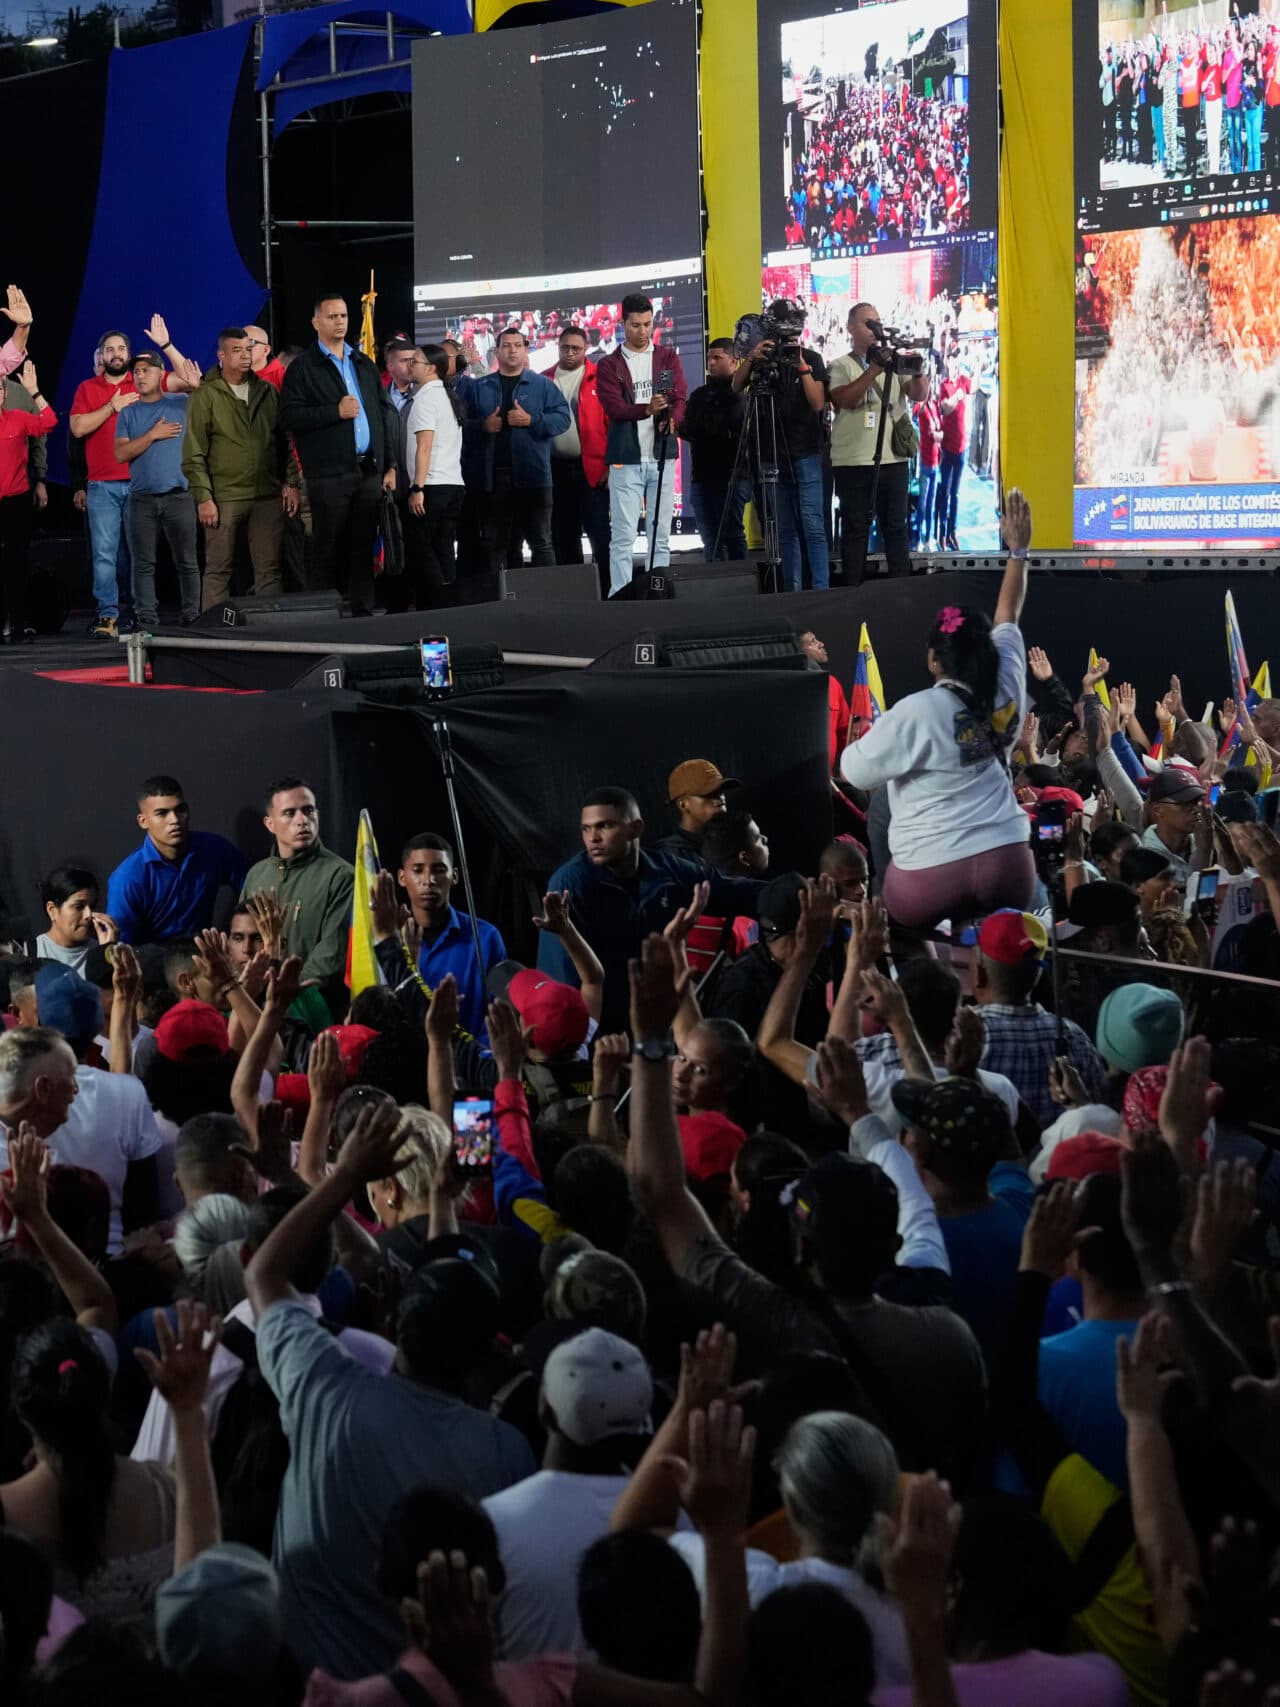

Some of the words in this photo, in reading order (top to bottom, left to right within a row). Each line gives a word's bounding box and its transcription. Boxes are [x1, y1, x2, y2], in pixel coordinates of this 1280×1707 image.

[1110, 472, 1145, 484] MIRANDA
[1134, 493, 1207, 512] JURAMENTACIÓN
[1209, 496, 1222, 511] DE
[1223, 495, 1240, 510] LOS
[1134, 514, 1198, 530] BOLIVARIANOS
[1199, 514, 1212, 529] DE
[1213, 514, 1237, 528] BASE
[655, 579, 661, 588] 3
[641, 647, 649, 661] 6
[329, 673, 336, 687] 8
